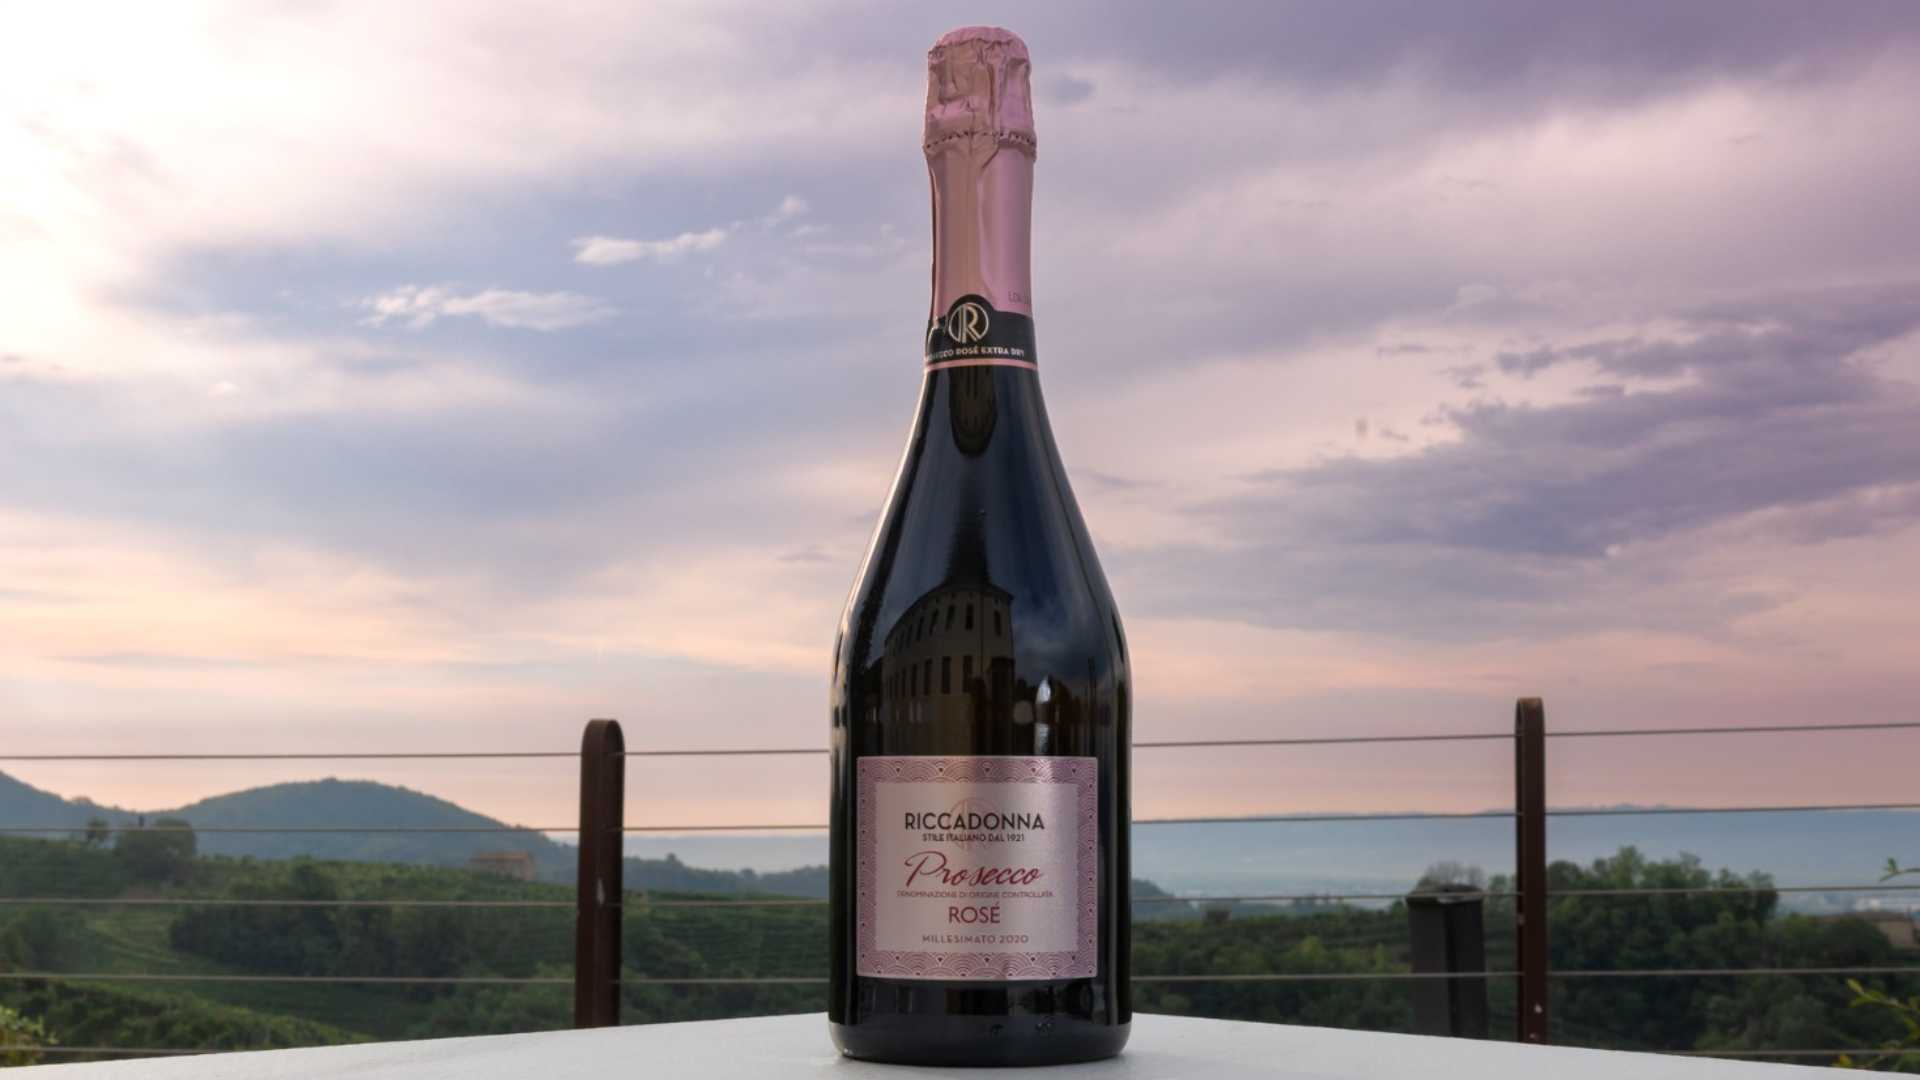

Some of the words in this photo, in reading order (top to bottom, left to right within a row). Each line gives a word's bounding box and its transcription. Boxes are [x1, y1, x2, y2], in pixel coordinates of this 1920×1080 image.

[981, 346, 1009, 355] EXTRA
[905, 812, 1045, 830] RICCADONNA
[922, 833, 945, 842] STILE
[946, 833, 986, 842] ITALIANO
[988, 833, 1005, 842] DAL
[1007, 833, 1025, 842] 1921
[904, 850, 1042, 887] Prosecco
[896, 890, 957, 898] DENOMINAZIONE
[1001, 890, 1053, 898] CONTROLLATA
[948, 902, 1001, 923] ROSÉ
[922, 934, 996, 944] MILLESIMATO
[999, 934, 1029, 944] 2020
